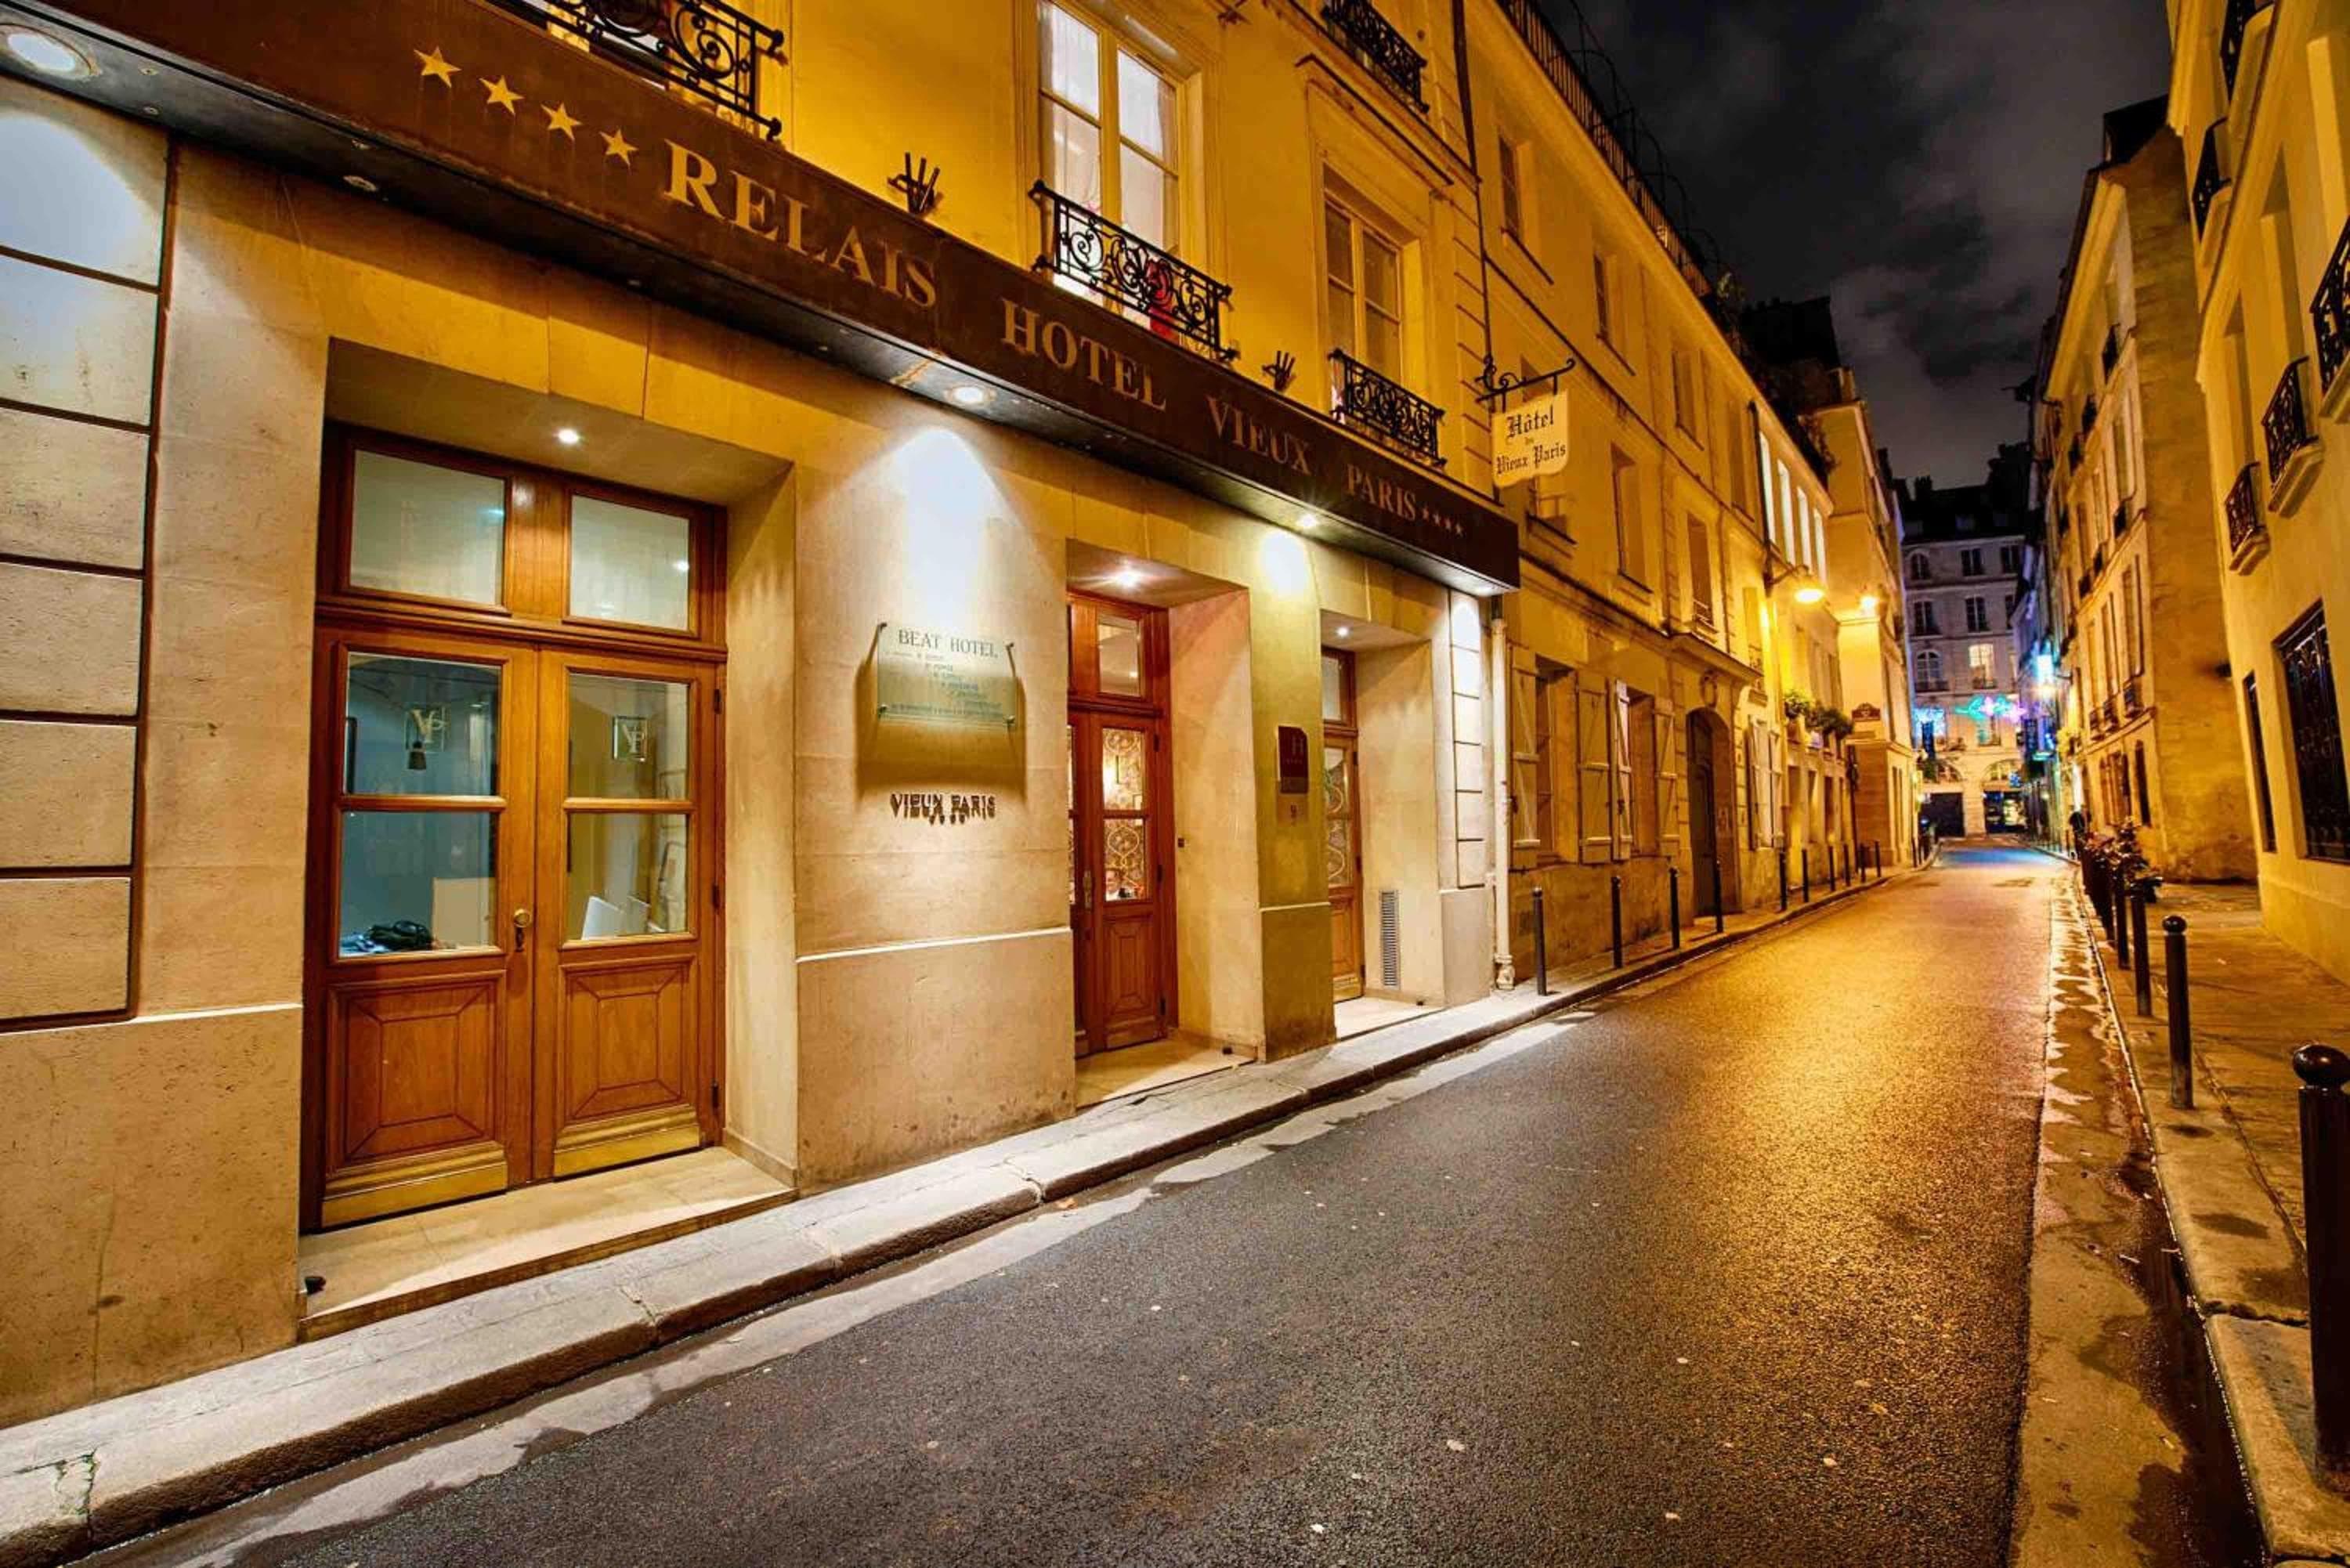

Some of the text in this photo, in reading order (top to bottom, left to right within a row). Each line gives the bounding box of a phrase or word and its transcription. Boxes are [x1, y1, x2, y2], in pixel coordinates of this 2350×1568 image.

[663, 139, 1417, 522] RELAIS HOTEL VIEUX PARIS
[1506, 405, 1554, 438] Hôtel
[1496, 443, 1566, 474] Vieux Paris
[898, 629, 940, 650] BEAT
[950, 638, 999, 659] HOTEL
[890, 793, 996, 815] VIEUX PARIS
